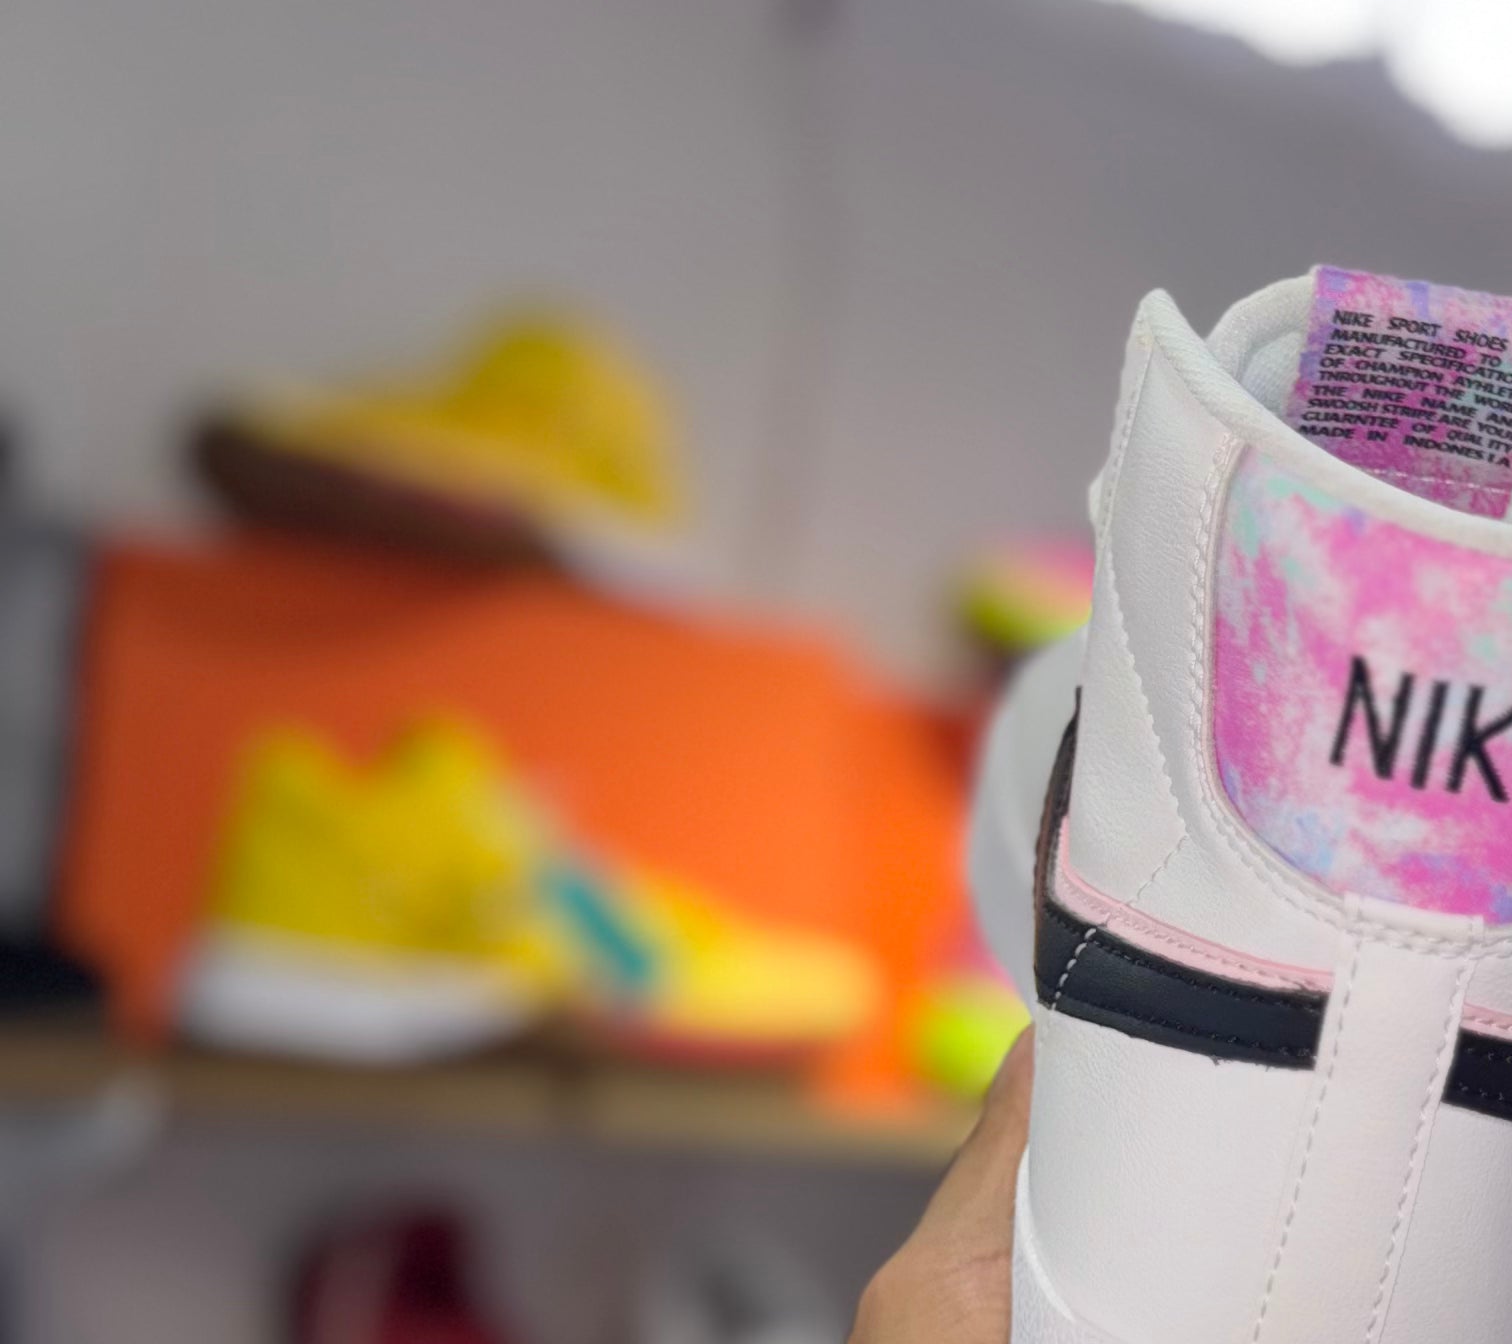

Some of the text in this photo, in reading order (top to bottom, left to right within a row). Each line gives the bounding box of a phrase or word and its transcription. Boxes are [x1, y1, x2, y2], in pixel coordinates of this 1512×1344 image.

[1332, 310, 1374, 327] NIKE
[1387, 317, 1441, 337] SPORT
[1453, 329, 1510, 352] SHOES
[1323, 343, 1386, 358] EXACT
[1330, 328, 1467, 357] MANUFACTURED
[1480, 353, 1502, 367] TO
[1320, 357, 1345, 368] OF
[1355, 360, 1444, 381] CHAMPION
[1319, 370, 1430, 391] THROUGHOUT
[1434, 384, 1465, 400] THE
[1308, 398, 1379, 412] SWOOSH
[1382, 404, 1437, 421] STRIPE
[1438, 414, 1472, 429] ARE
[1312, 385, 1348, 397] THE
[1362, 388, 1406, 402] NIKE
[1420, 397, 1478, 418] NAME
[1299, 425, 1355, 439] MADE
[1367, 430, 1388, 442] IN
[1411, 422, 1437, 434] OF
